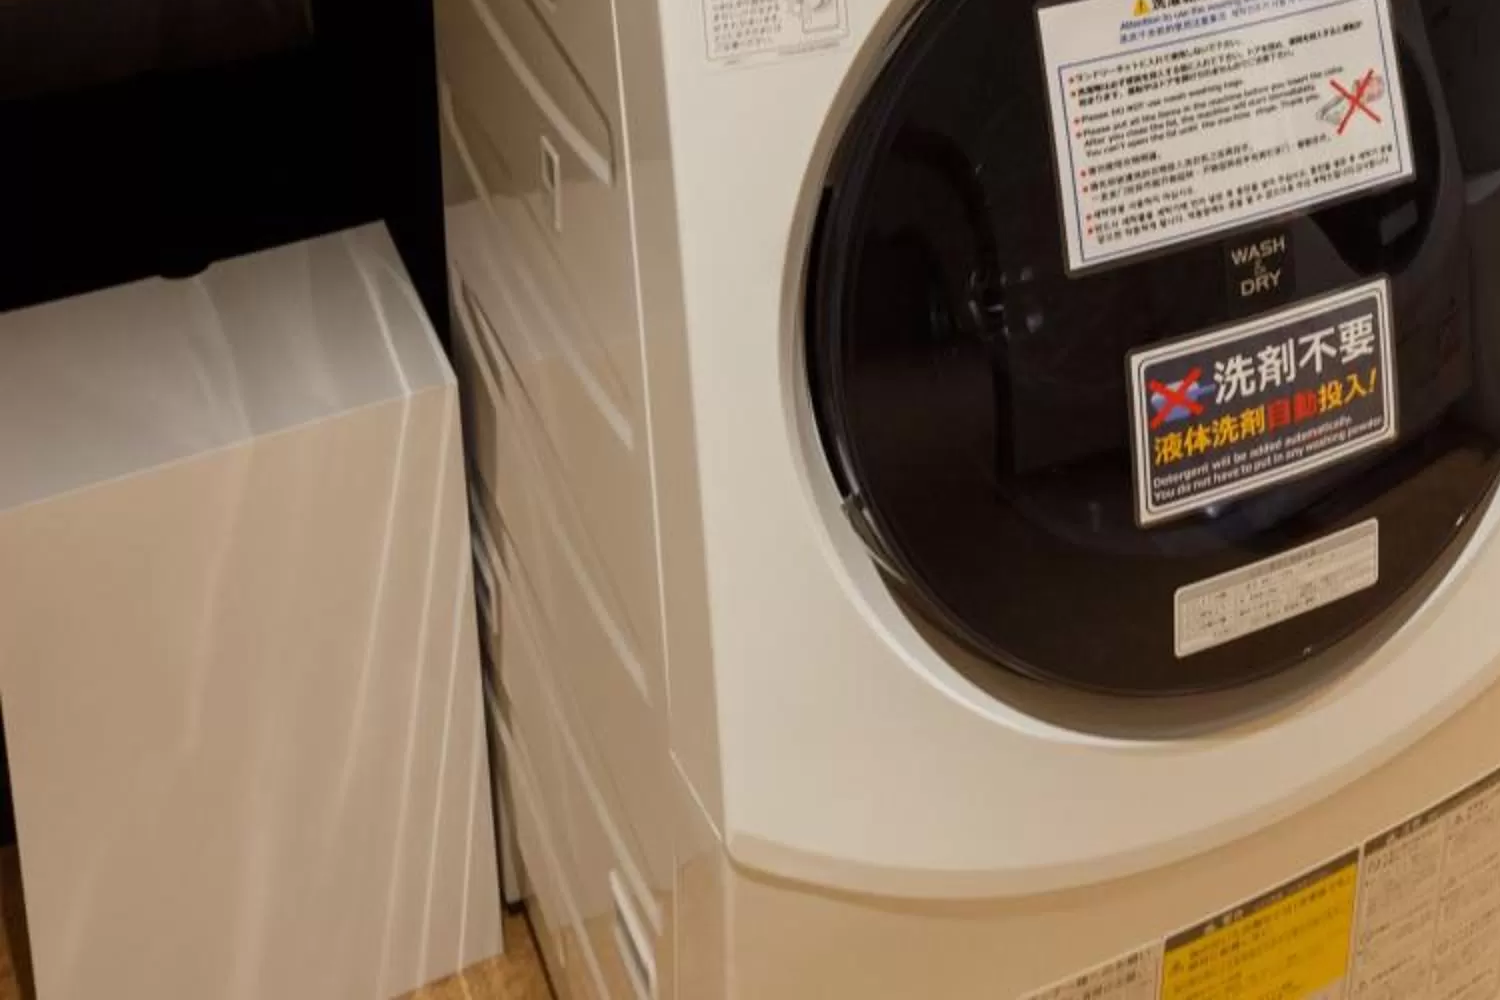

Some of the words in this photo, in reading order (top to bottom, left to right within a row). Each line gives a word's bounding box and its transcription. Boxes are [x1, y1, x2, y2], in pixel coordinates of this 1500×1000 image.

[1231, 234, 1286, 265] WASH
[1240, 269, 1281, 297] DRY
[1213, 313, 1375, 404] 洗剤不要
[1153, 463, 1209, 489] Detergent
[1212, 457, 1231, 471] will
[1234, 451, 1246, 465] be
[1249, 440, 1281, 459] added
[1153, 487, 1174, 504] You
[1177, 481, 1191, 494] do
[1193, 473, 1211, 489] not
[1214, 467, 1237, 484] have
[1239, 463, 1252, 475] to
[1253, 457, 1271, 474] put
[1285, 447, 1303, 463] any
[1306, 432, 1345, 454] washing
